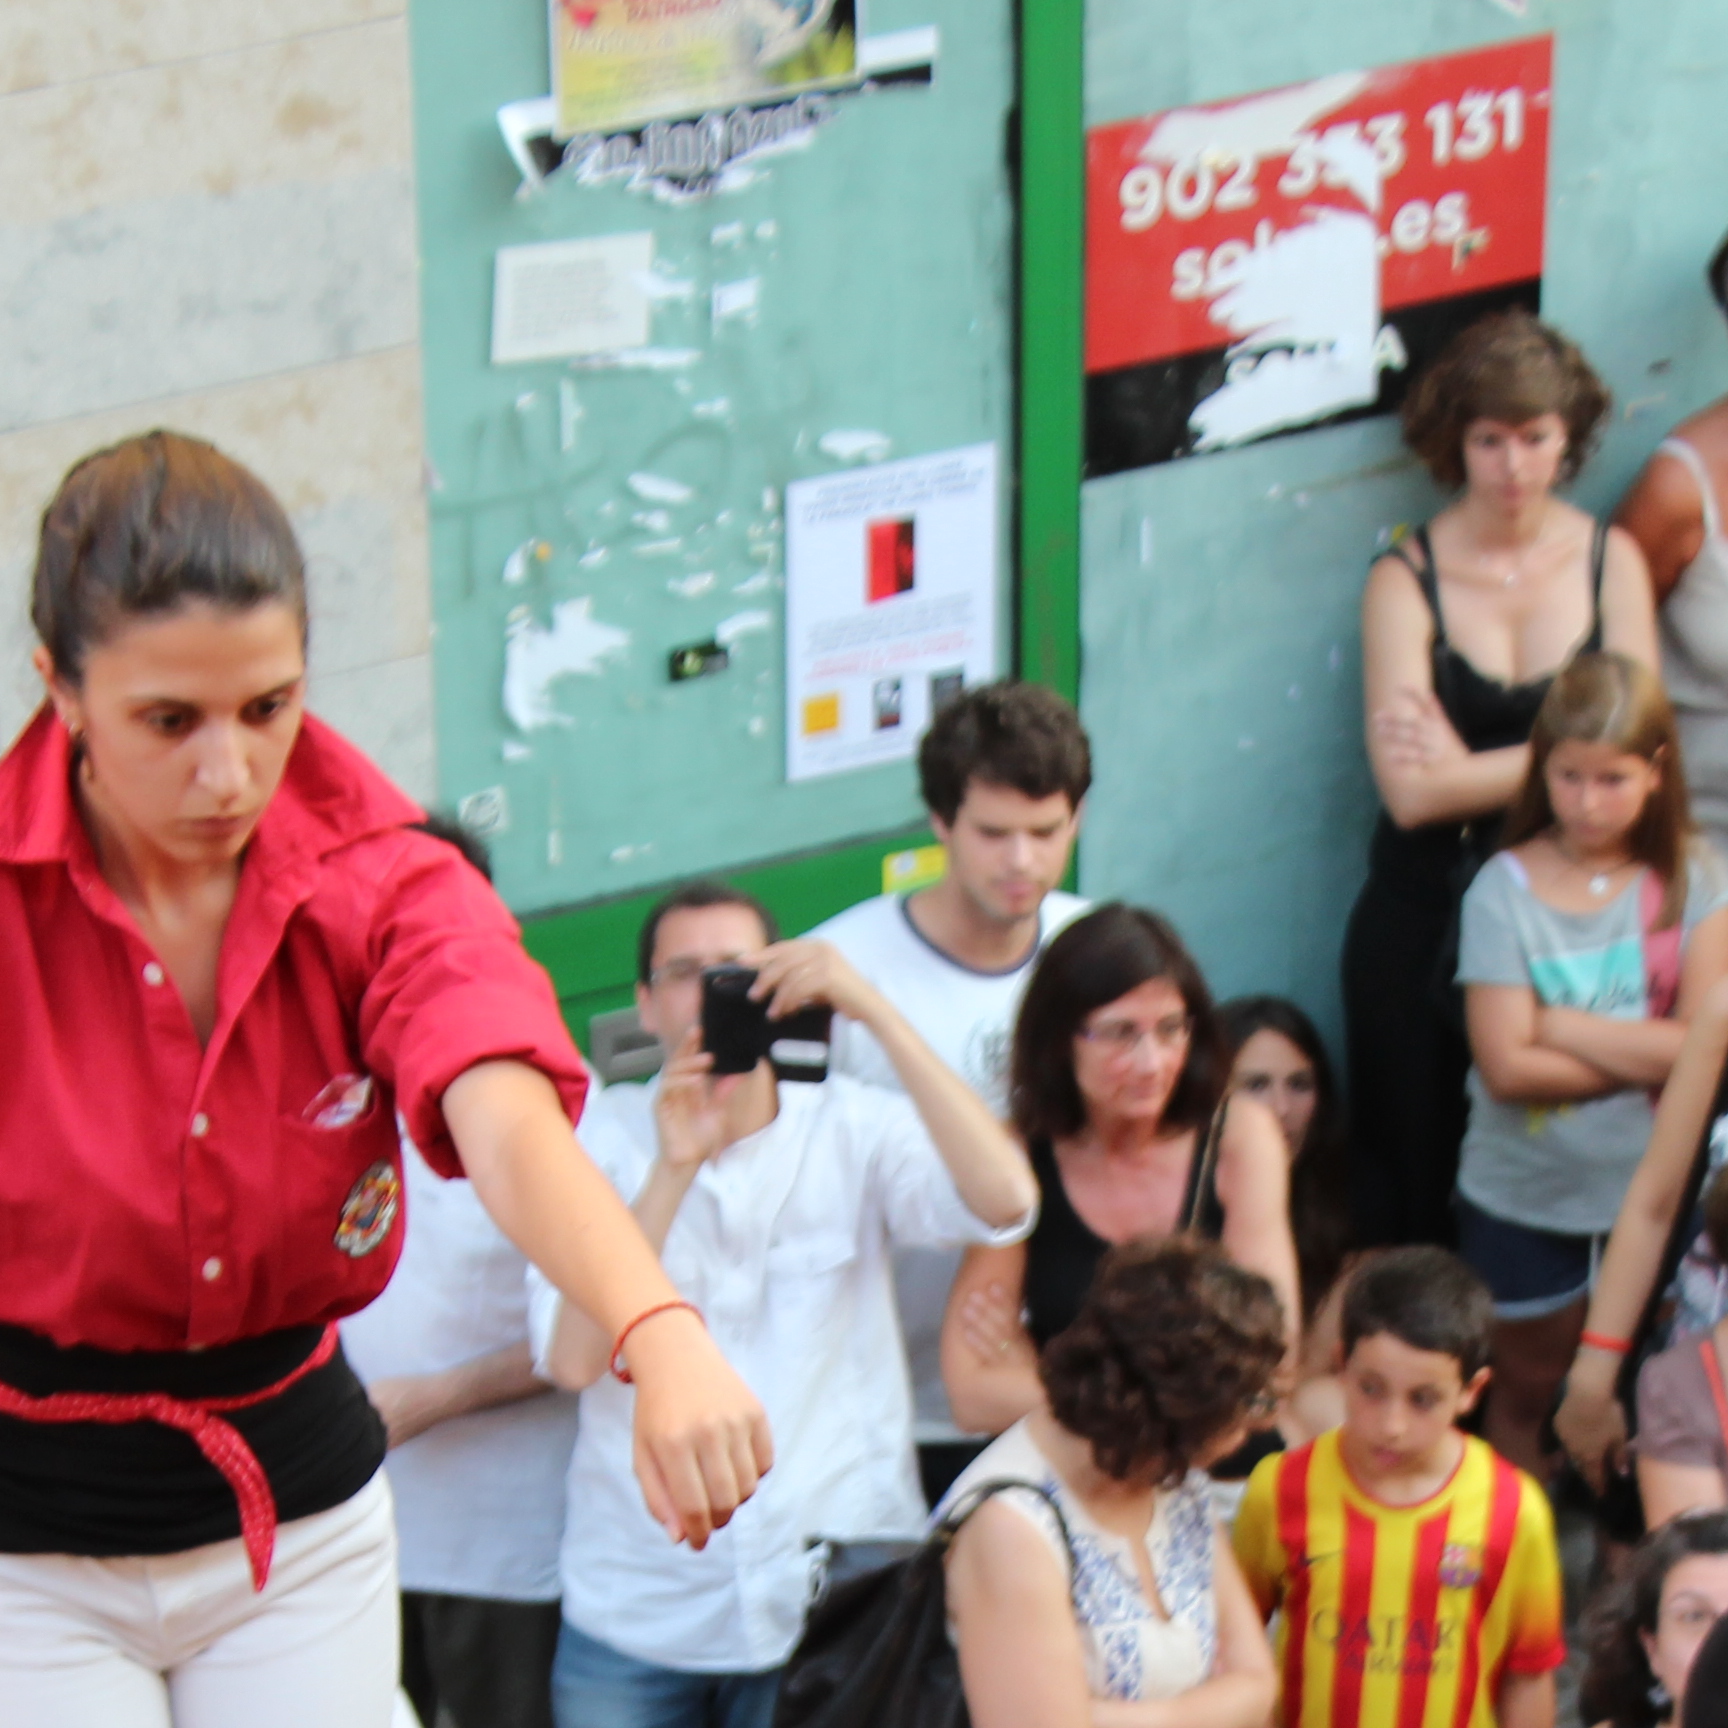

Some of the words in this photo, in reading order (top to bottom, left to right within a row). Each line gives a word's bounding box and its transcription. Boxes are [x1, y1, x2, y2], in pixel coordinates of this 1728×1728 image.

[1118, 151, 1259, 232] 902
[1424, 86, 1526, 166] 131
[1312, 1607, 1456, 1654] QATAR
